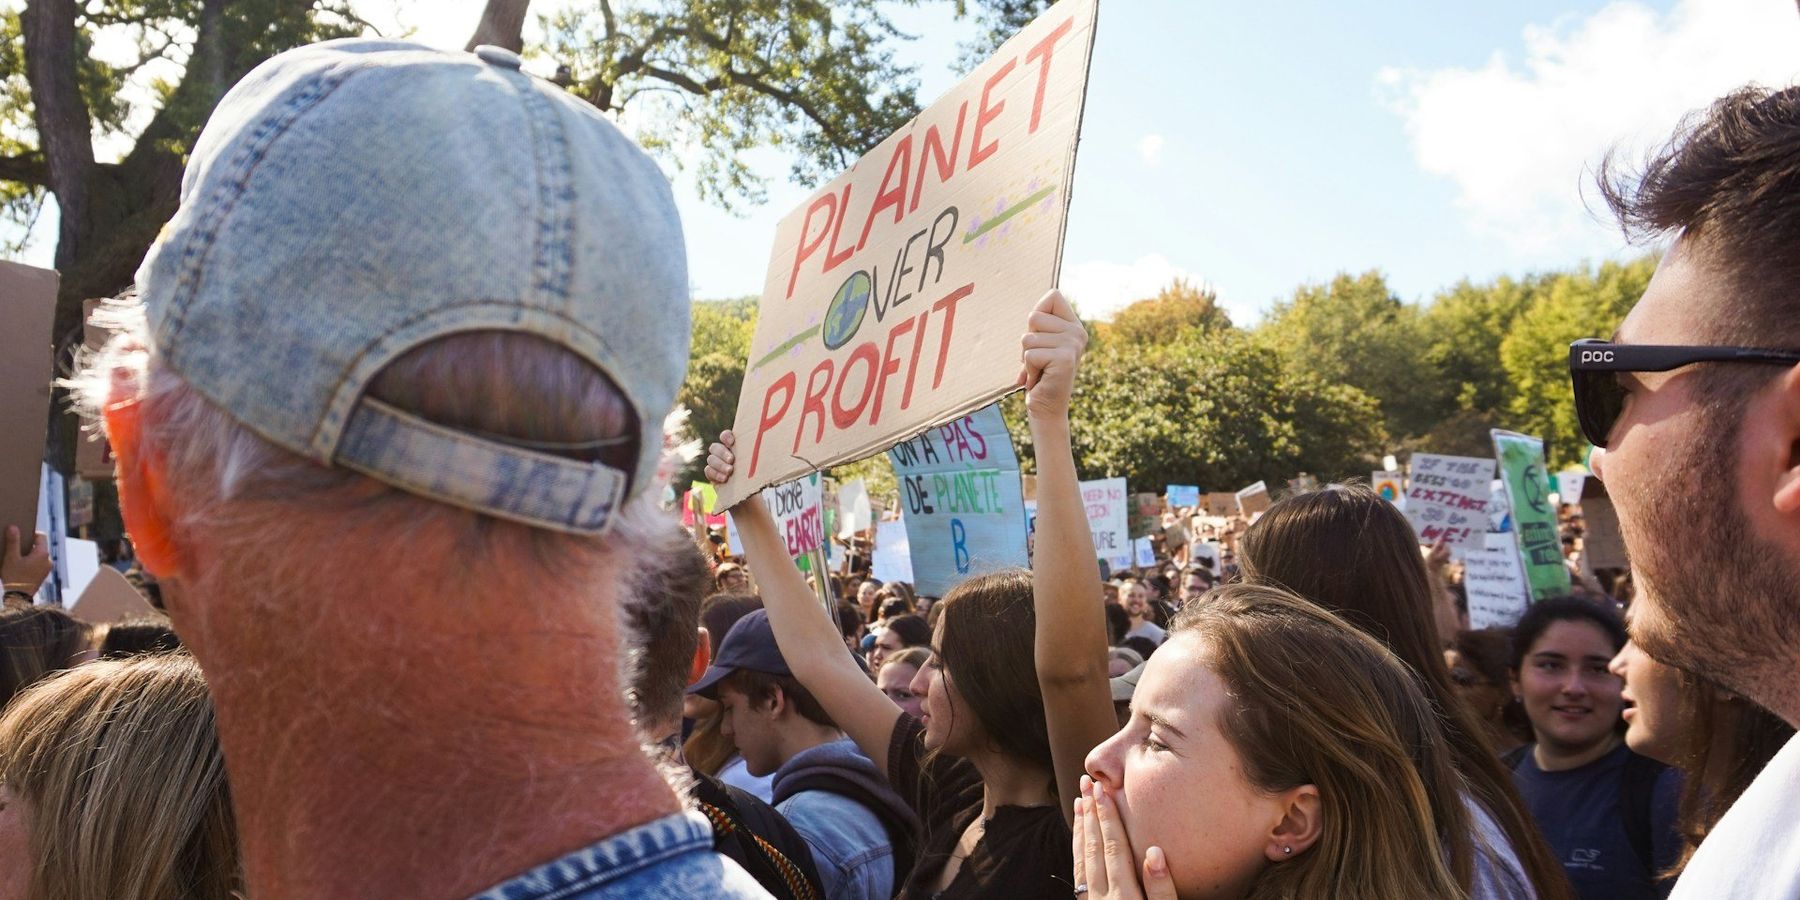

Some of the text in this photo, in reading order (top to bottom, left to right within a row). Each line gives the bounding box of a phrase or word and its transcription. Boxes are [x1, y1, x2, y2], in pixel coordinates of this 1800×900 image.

[786, 15, 1074, 300] PLANET
[823, 206, 959, 351] OVER
[748, 282, 975, 478] PROFIT
[893, 416, 987, 466] ON A PAS
[1446, 462, 1480, 474] THE
[905, 463, 1004, 515] DE PLANÈTE
[786, 502, 823, 556] EARTH
[951, 518, 970, 574] B
